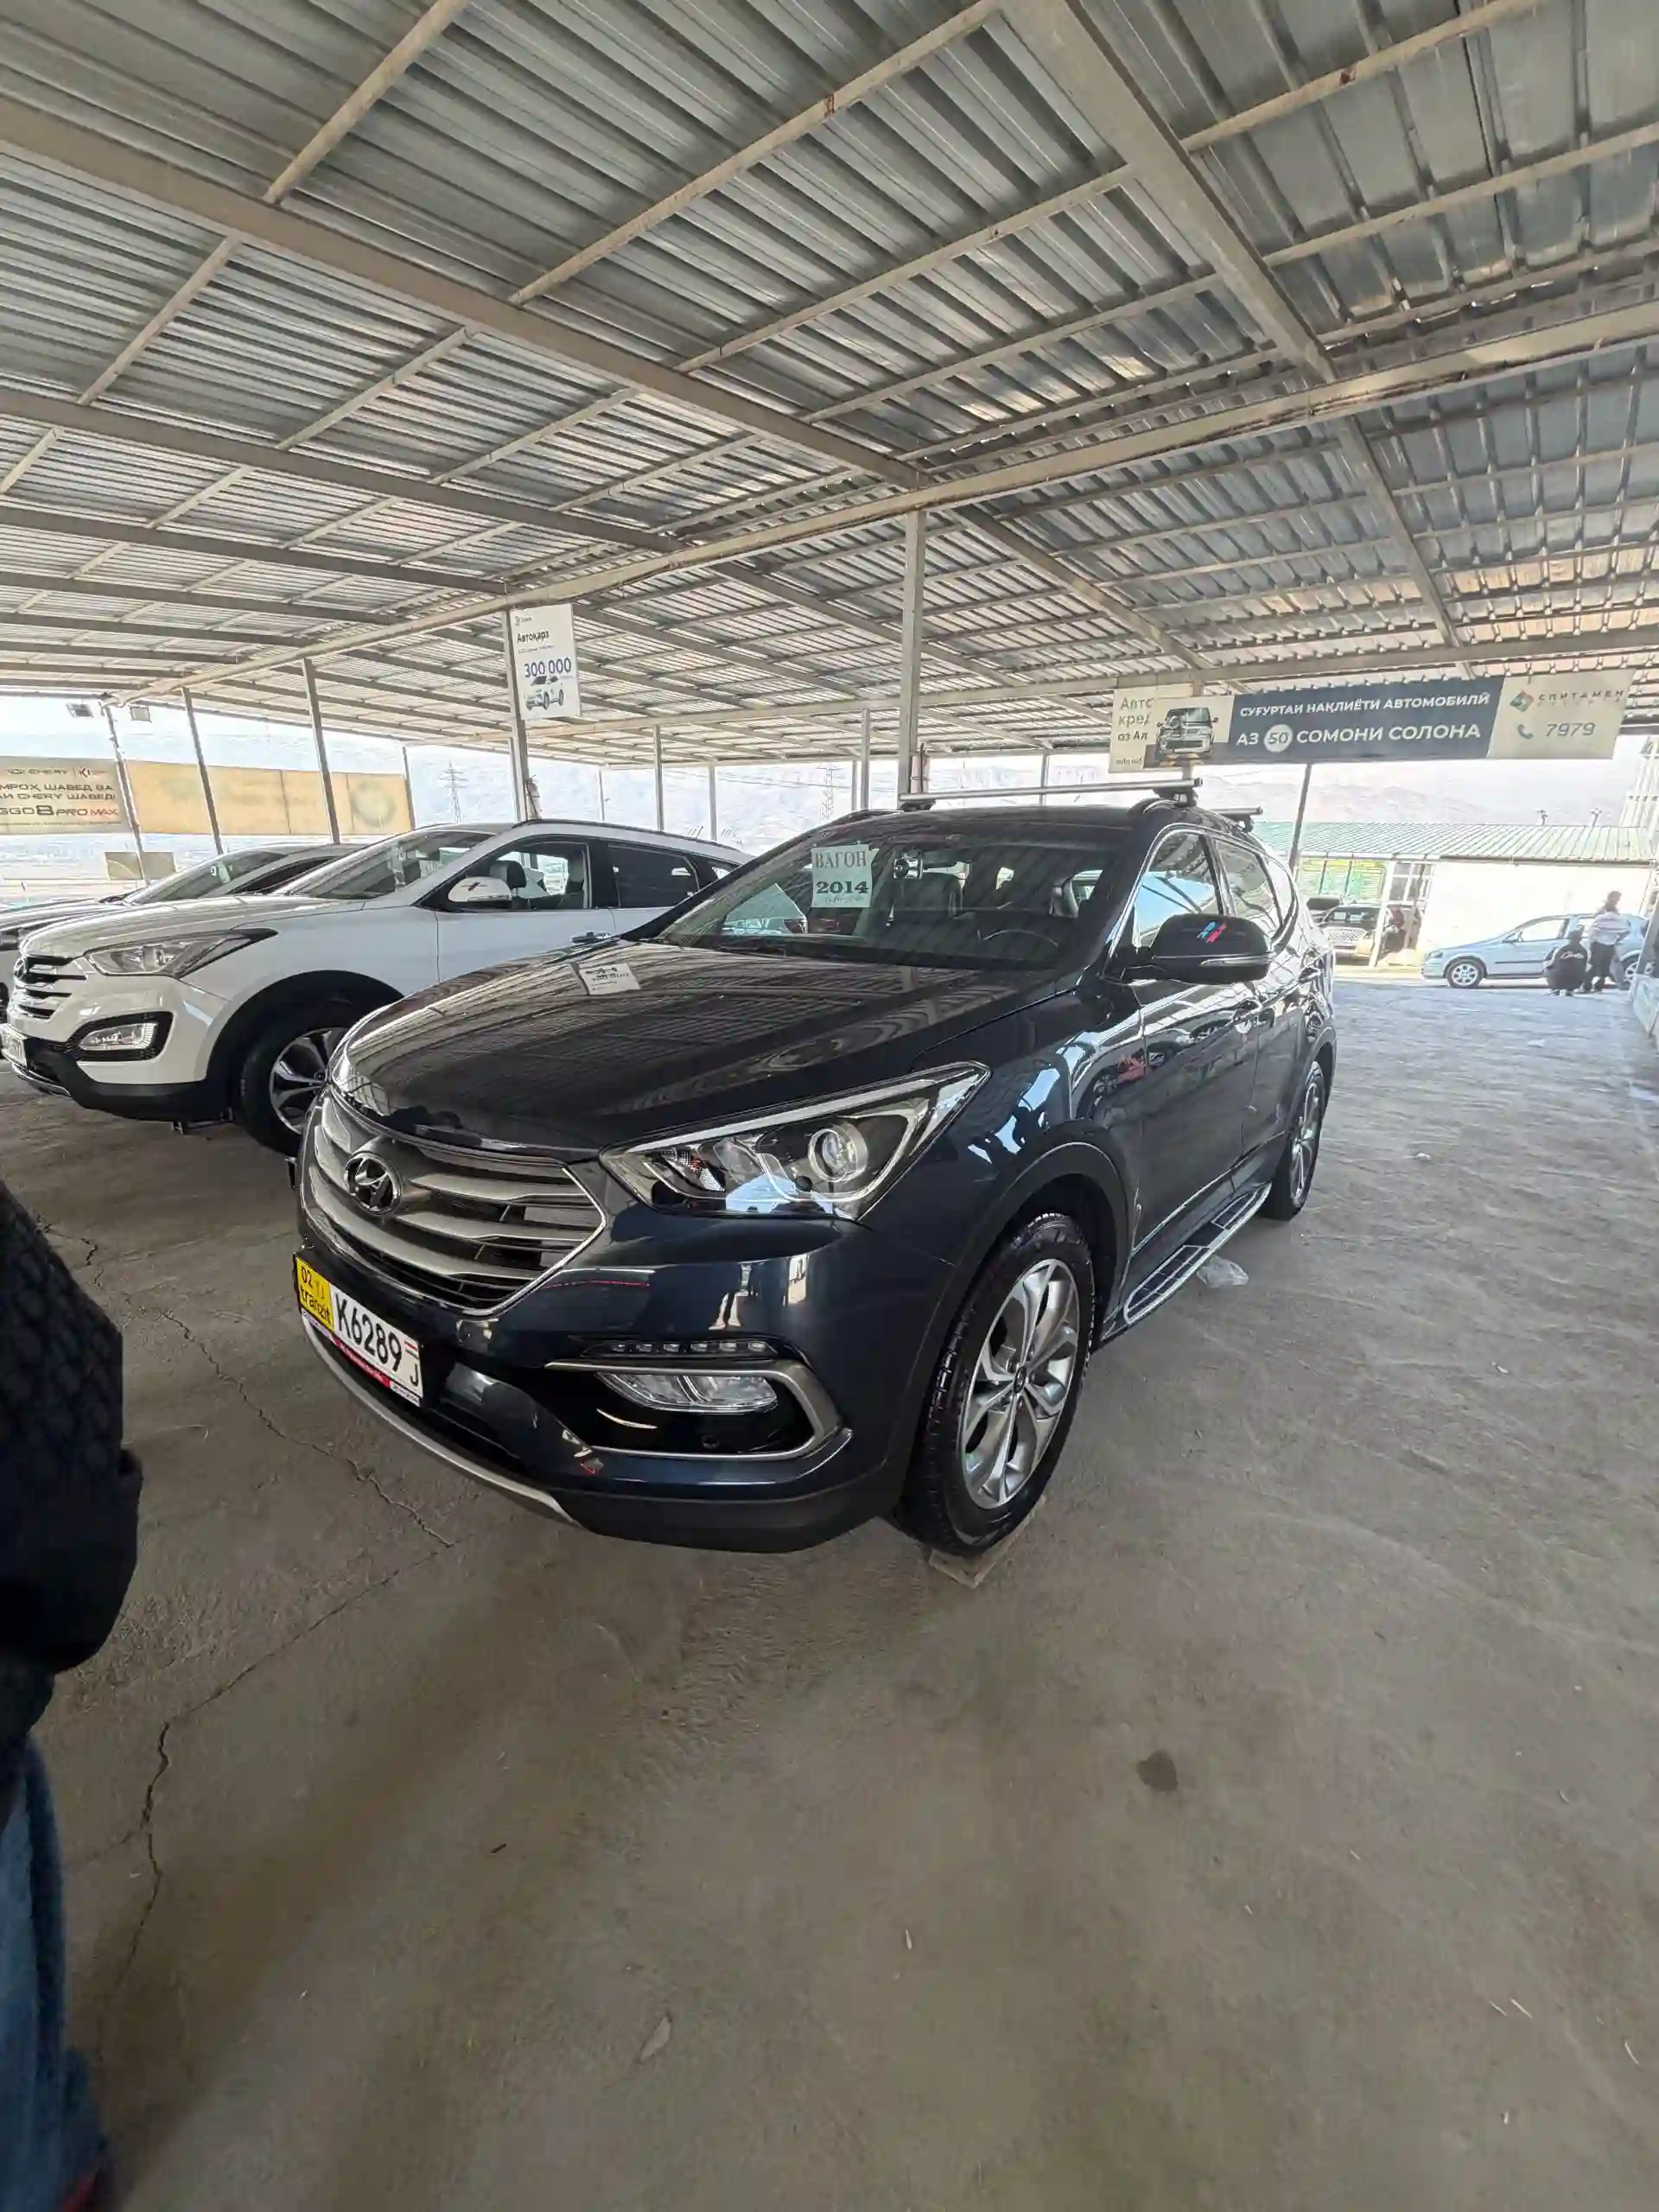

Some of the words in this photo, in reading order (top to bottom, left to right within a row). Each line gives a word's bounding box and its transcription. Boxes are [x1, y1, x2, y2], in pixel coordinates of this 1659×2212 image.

[524, 661, 545, 677] 300
[548, 657, 572, 674] 000
[1236, 732, 1259, 746] АЗ
[1268, 732, 1289, 745] 50
[1389, 724, 1481, 741] СОЛОНА
[1546, 721, 1596, 737] 7979
[816, 851, 867, 868] ВАГОН
[816, 880, 869, 894] 2014
[301, 1266, 313, 1290] 02
[335, 1294, 402, 1373] K6289
